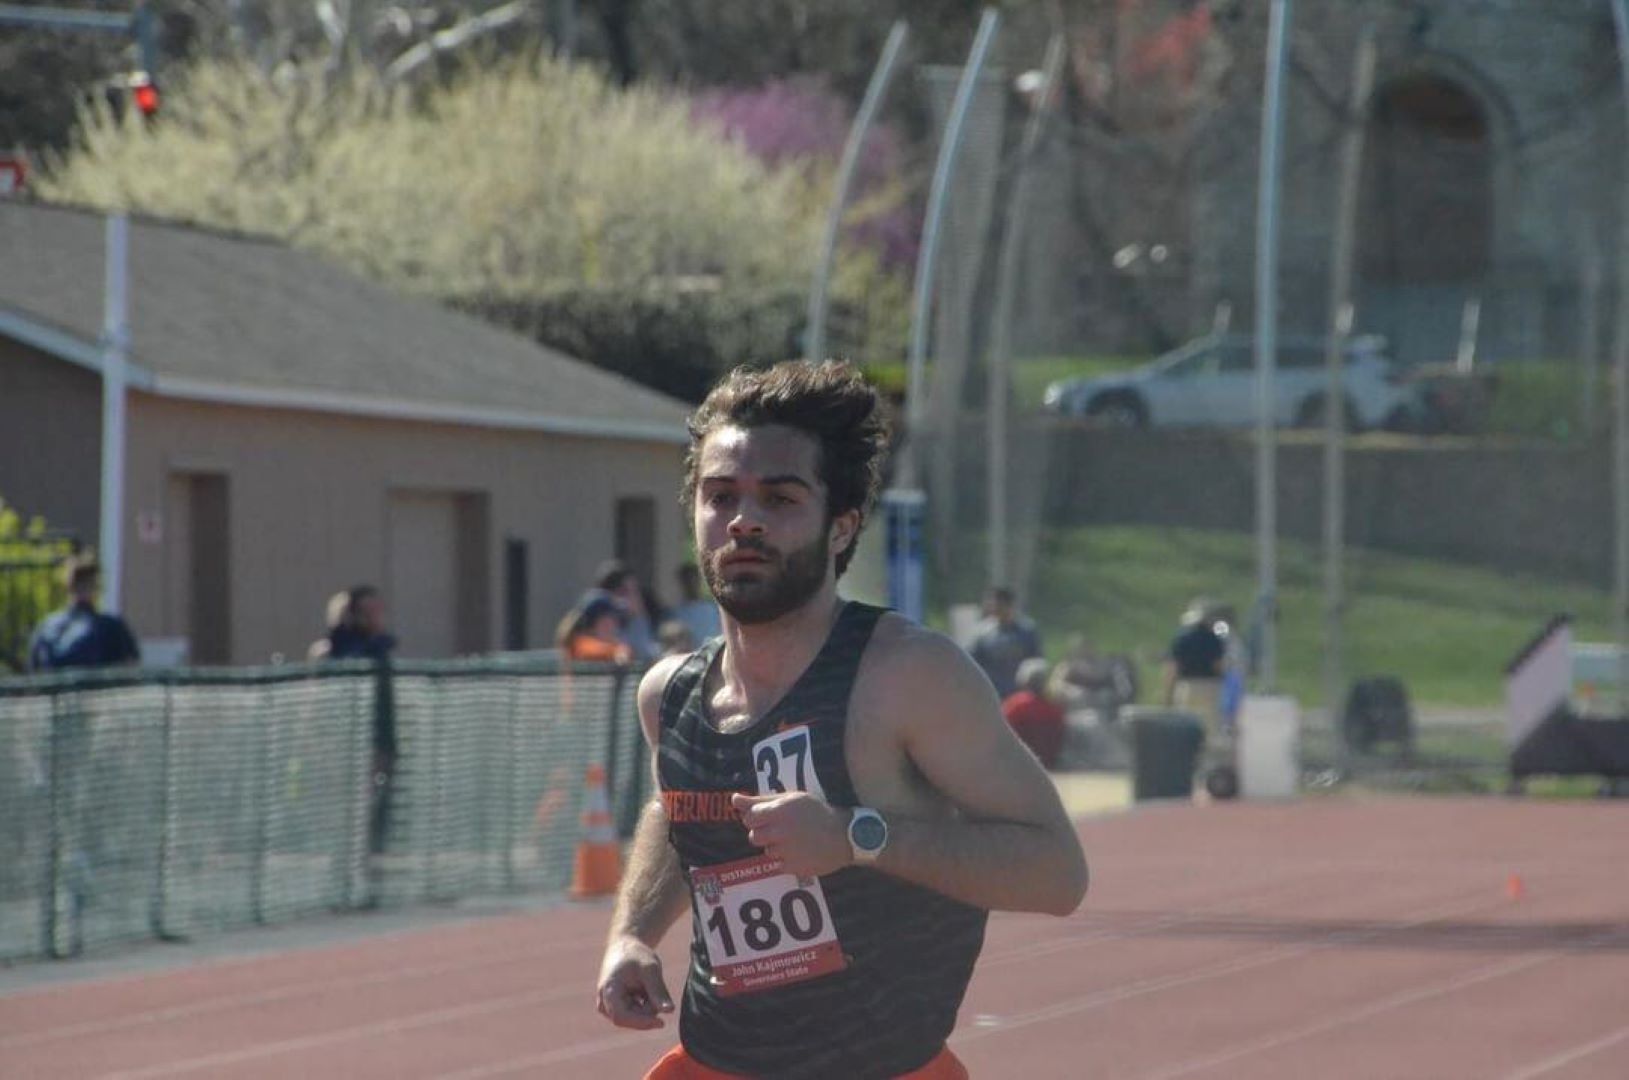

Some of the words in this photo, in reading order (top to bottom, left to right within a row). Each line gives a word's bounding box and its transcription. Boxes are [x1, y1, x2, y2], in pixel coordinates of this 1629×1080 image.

[756, 733, 808, 793] 37
[661, 790, 747, 823] VERNOR
[720, 865, 762, 882] DISTANCE
[763, 861, 782, 873] CAR
[707, 889, 823, 957] 180
[732, 964, 756, 977] John
